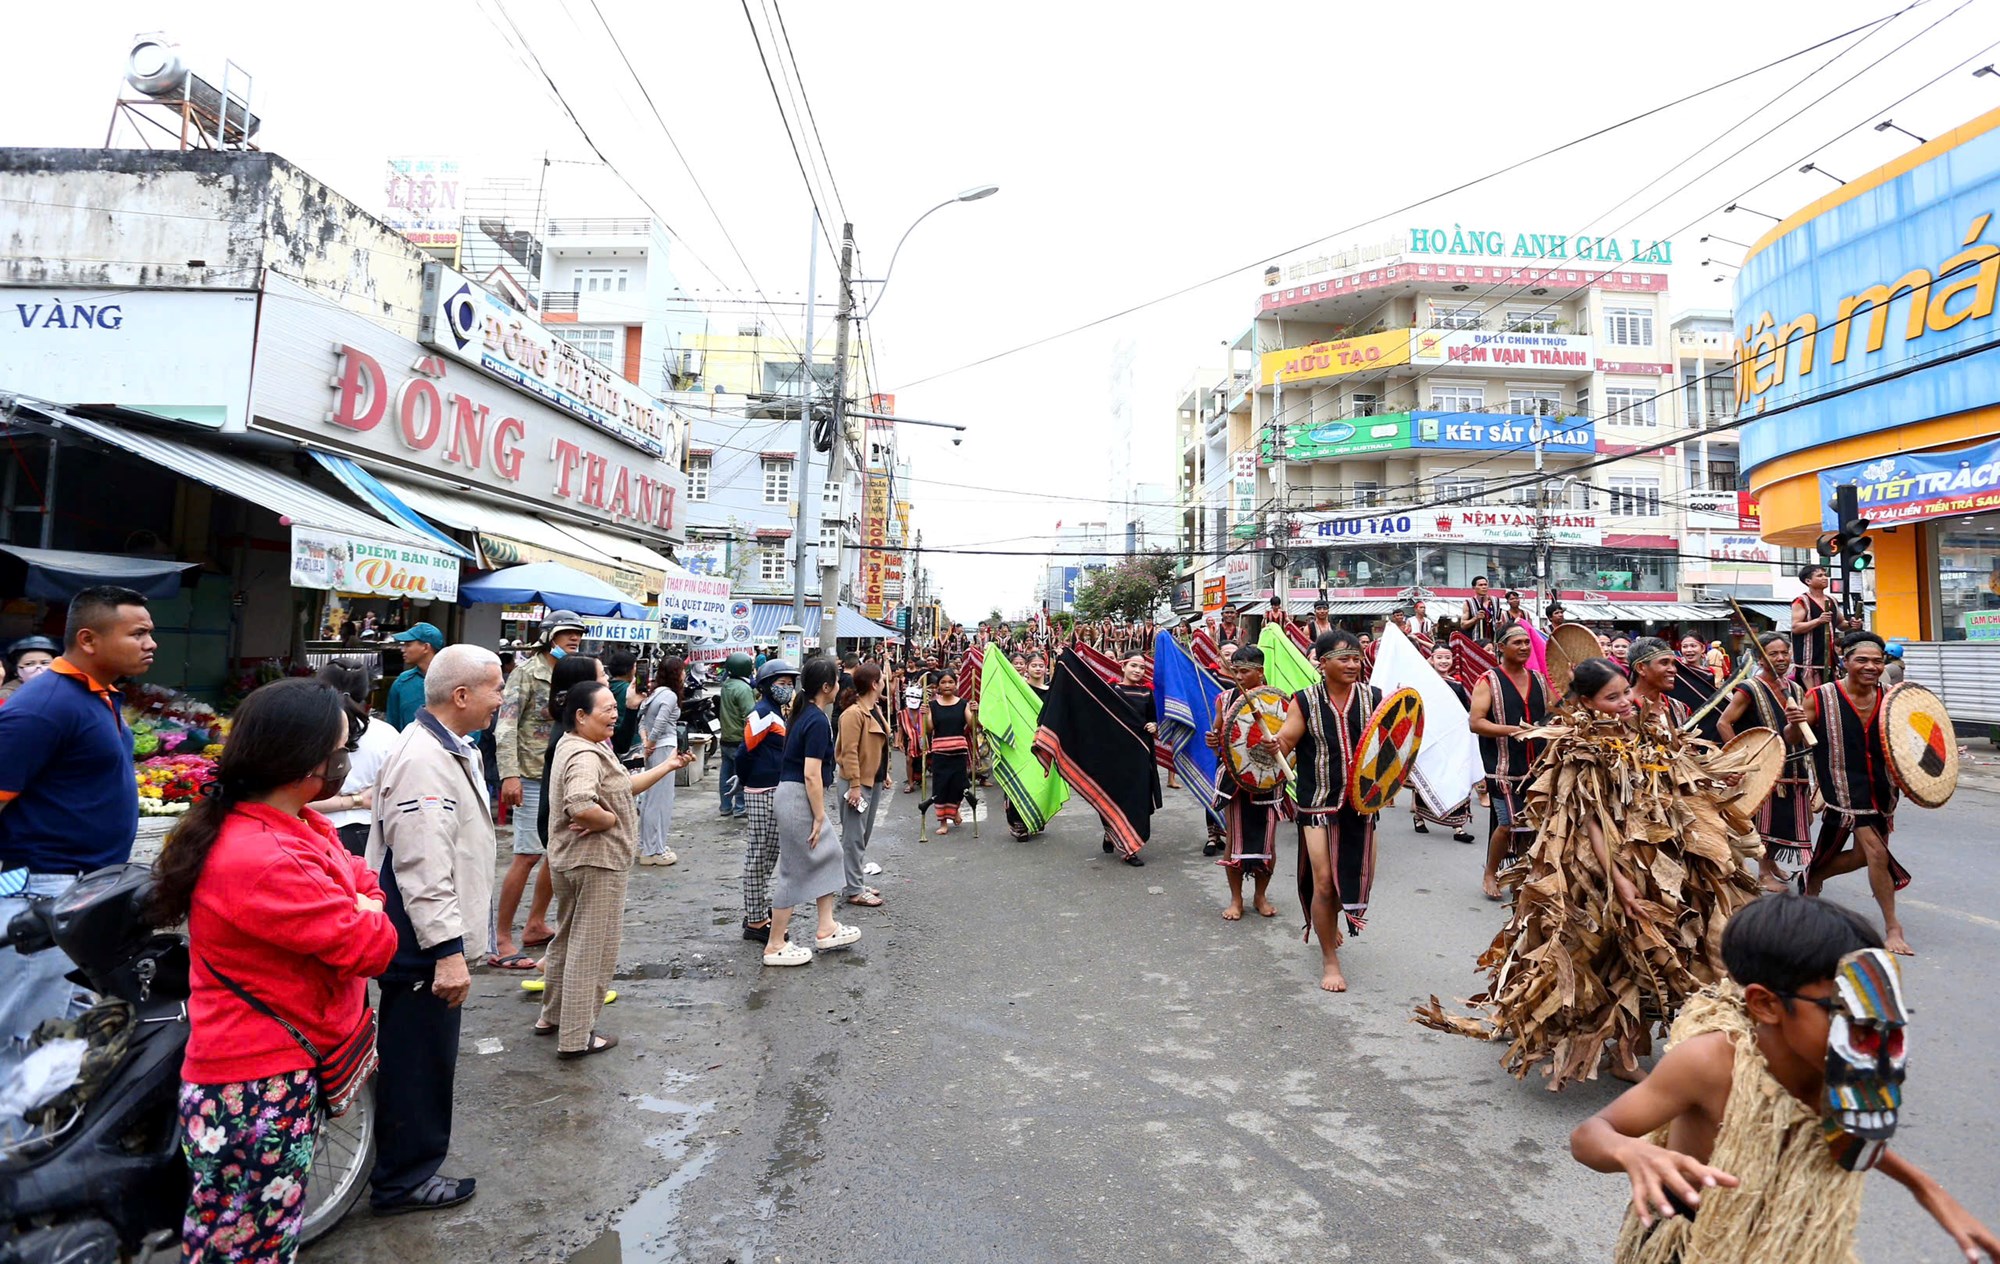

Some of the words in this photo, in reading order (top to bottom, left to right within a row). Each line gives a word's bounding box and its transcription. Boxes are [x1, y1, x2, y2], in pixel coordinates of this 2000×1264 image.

[1410, 223, 1504, 255] HOÀNG
[1512, 233, 1568, 259] ANH
[1576, 236, 1623, 262] GIA
[1632, 239, 1672, 264] LAI
[17, 298, 123, 329] VÀNG
[1474, 334, 1492, 345] ĐẠI
[1494, 334, 1505, 344] LÝ
[1508, 335, 1539, 346] CHÍNH
[1541, 336, 1567, 346] THỨC
[1285, 354, 1330, 374] HỮU
[1338, 346, 1381, 366] TẠO
[1448, 344, 1487, 364] NỆM
[1492, 347, 1526, 365] VẠN
[1530, 346, 1587, 366] THÀNH
[325, 342, 525, 482] ĐỒNG
[551, 438, 676, 530] THẠNH
[1446, 420, 1484, 441] KÉT
[1489, 420, 1524, 442] SẮT
[1875, 471, 1916, 501] TẾT
[1880, 507, 1897, 518] XÀI
[1899, 502, 1921, 516] LIỀN
[1925, 498, 1950, 513] TIỀN
[1951, 497, 1974, 510] TRẢ
[1368, 516, 1411, 536] TẠO
[1462, 511, 1496, 526] NỆM
[1501, 513, 1536, 527] VẠN
[356, 542, 397, 560] ĐIỂM
[433, 556, 457, 570] HOA
[1830, 539, 1838, 553] 5
[355, 558, 429, 593] Vân
[667, 577, 682, 591] THAY
[684, 579, 696, 592] PIN
[703, 601, 725, 613] ZIPPO
[606, 623, 627, 639] KÉT
[630, 622, 652, 640] SẮT
